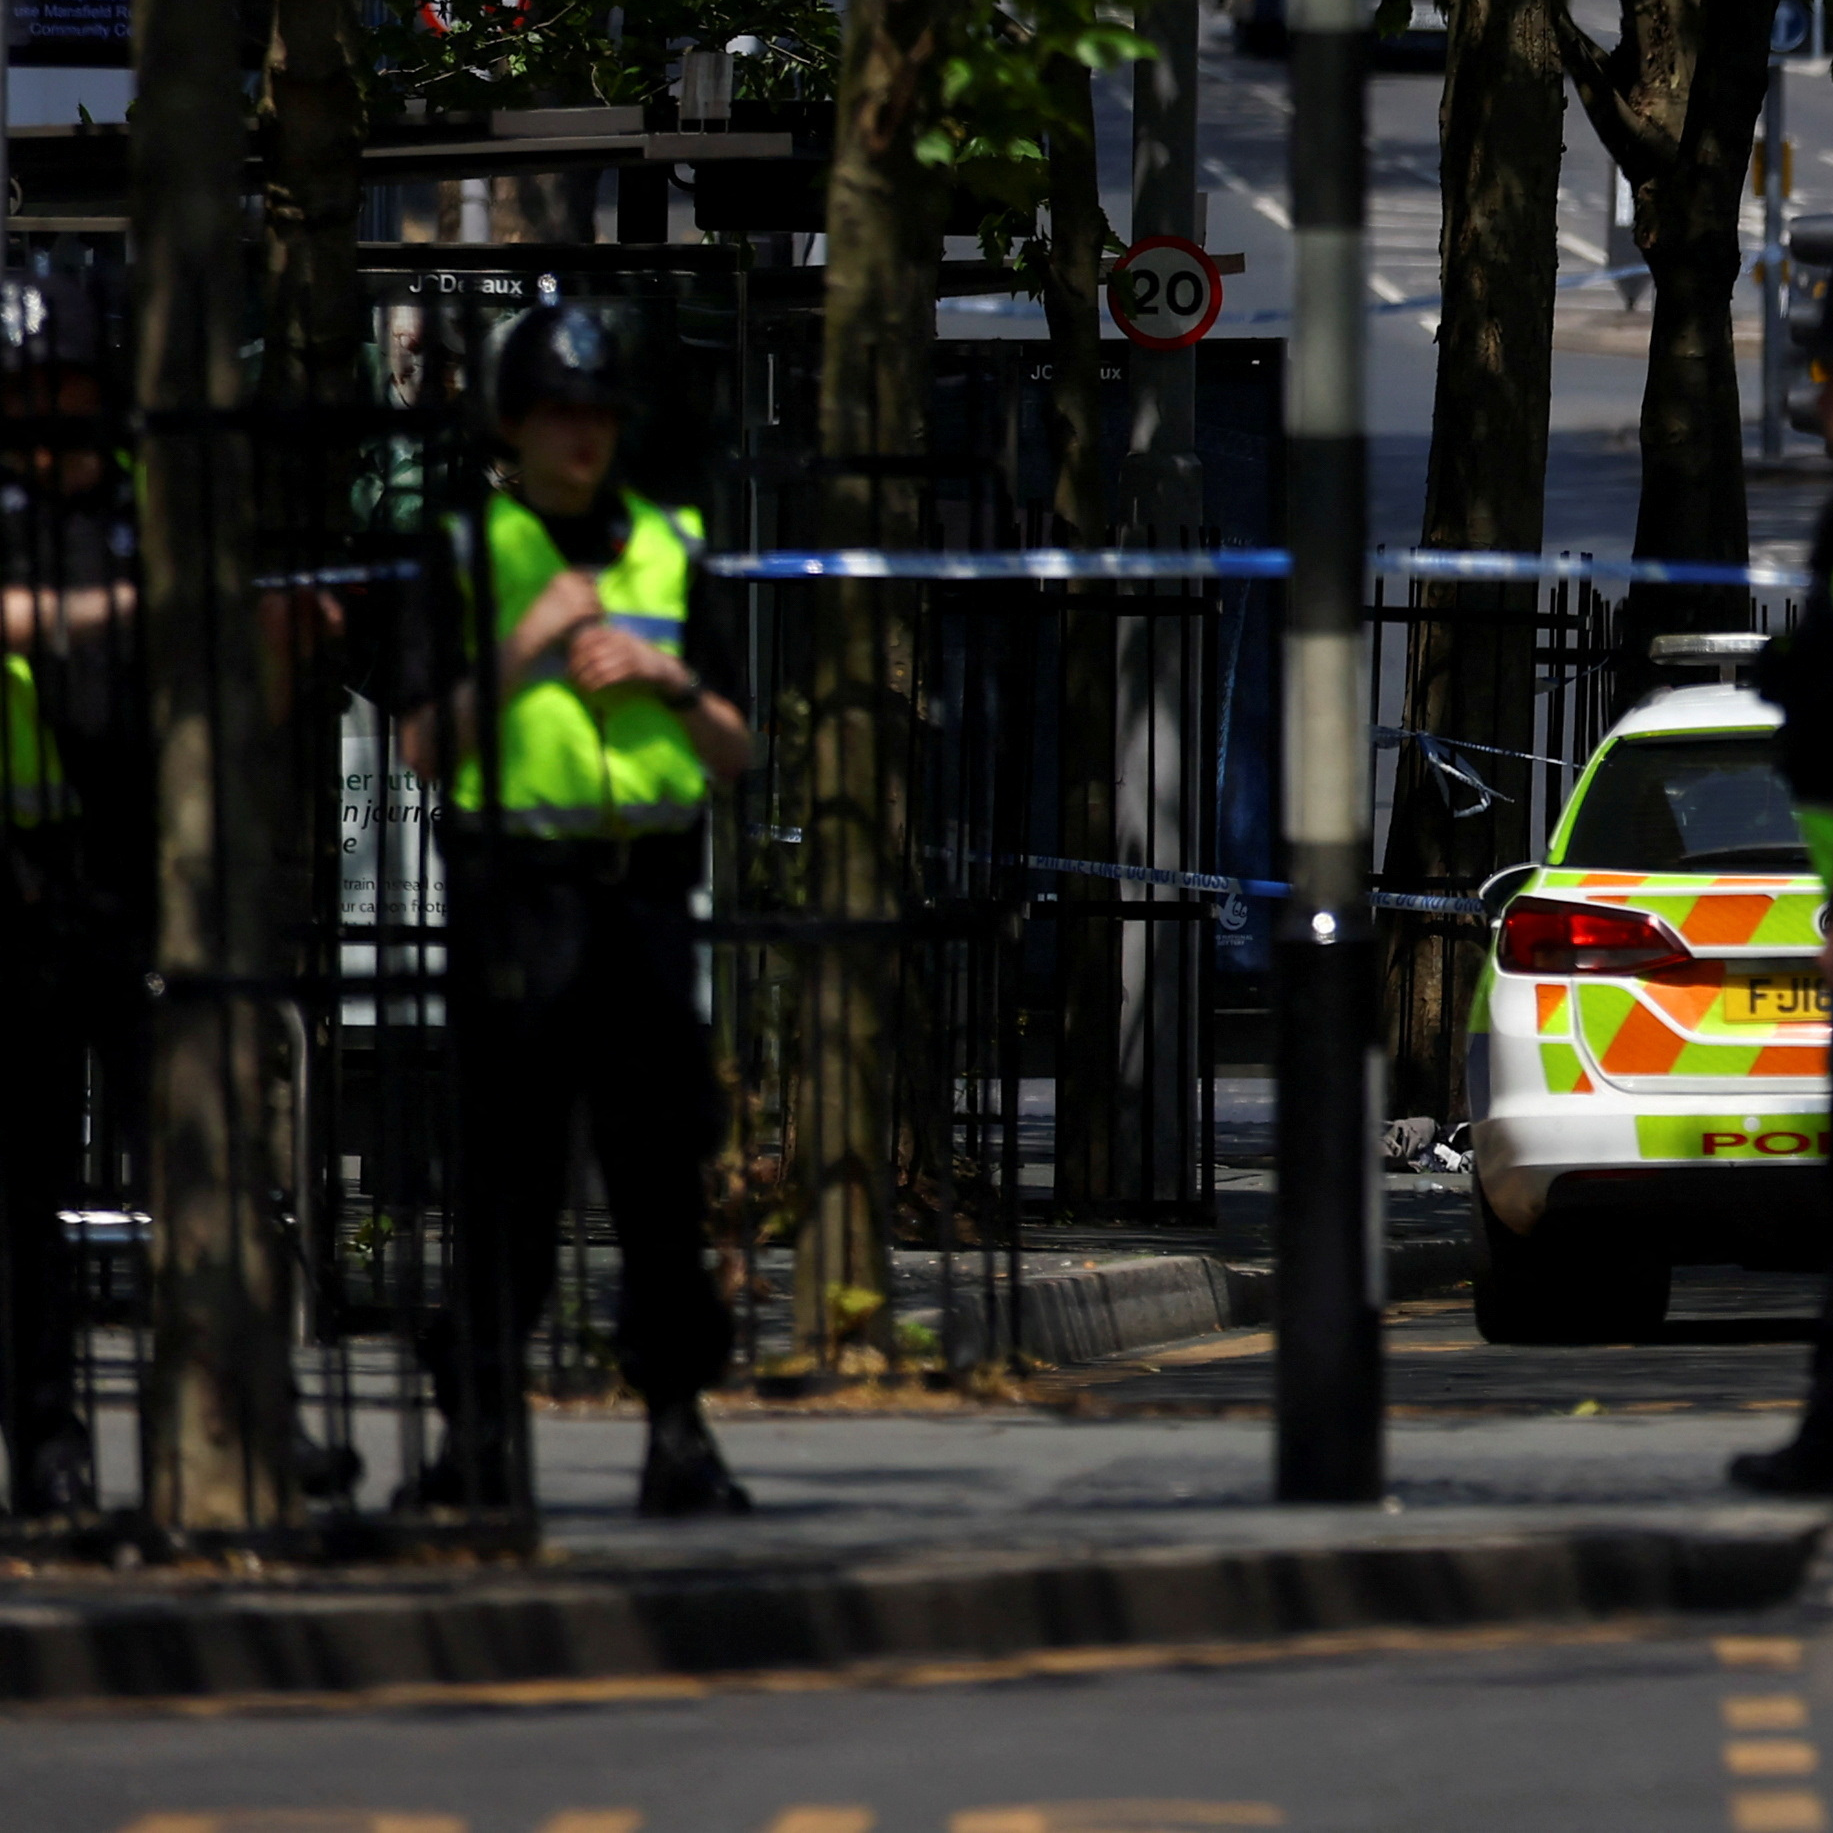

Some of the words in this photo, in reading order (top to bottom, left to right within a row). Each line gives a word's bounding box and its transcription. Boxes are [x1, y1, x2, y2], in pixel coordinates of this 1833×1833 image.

[1131, 269, 1204, 316] 20
[344, 877, 375, 891] train
[1037, 855, 1085, 874] POLICE
[1089, 863, 1123, 879] LINE
[1127, 866, 1147, 881] DO
[1151, 868, 1178, 884] NOT
[1184, 872, 1230, 890] CROSS
[1420, 895, 1448, 909] NOT
[1454, 897, 1484, 913] CRO
